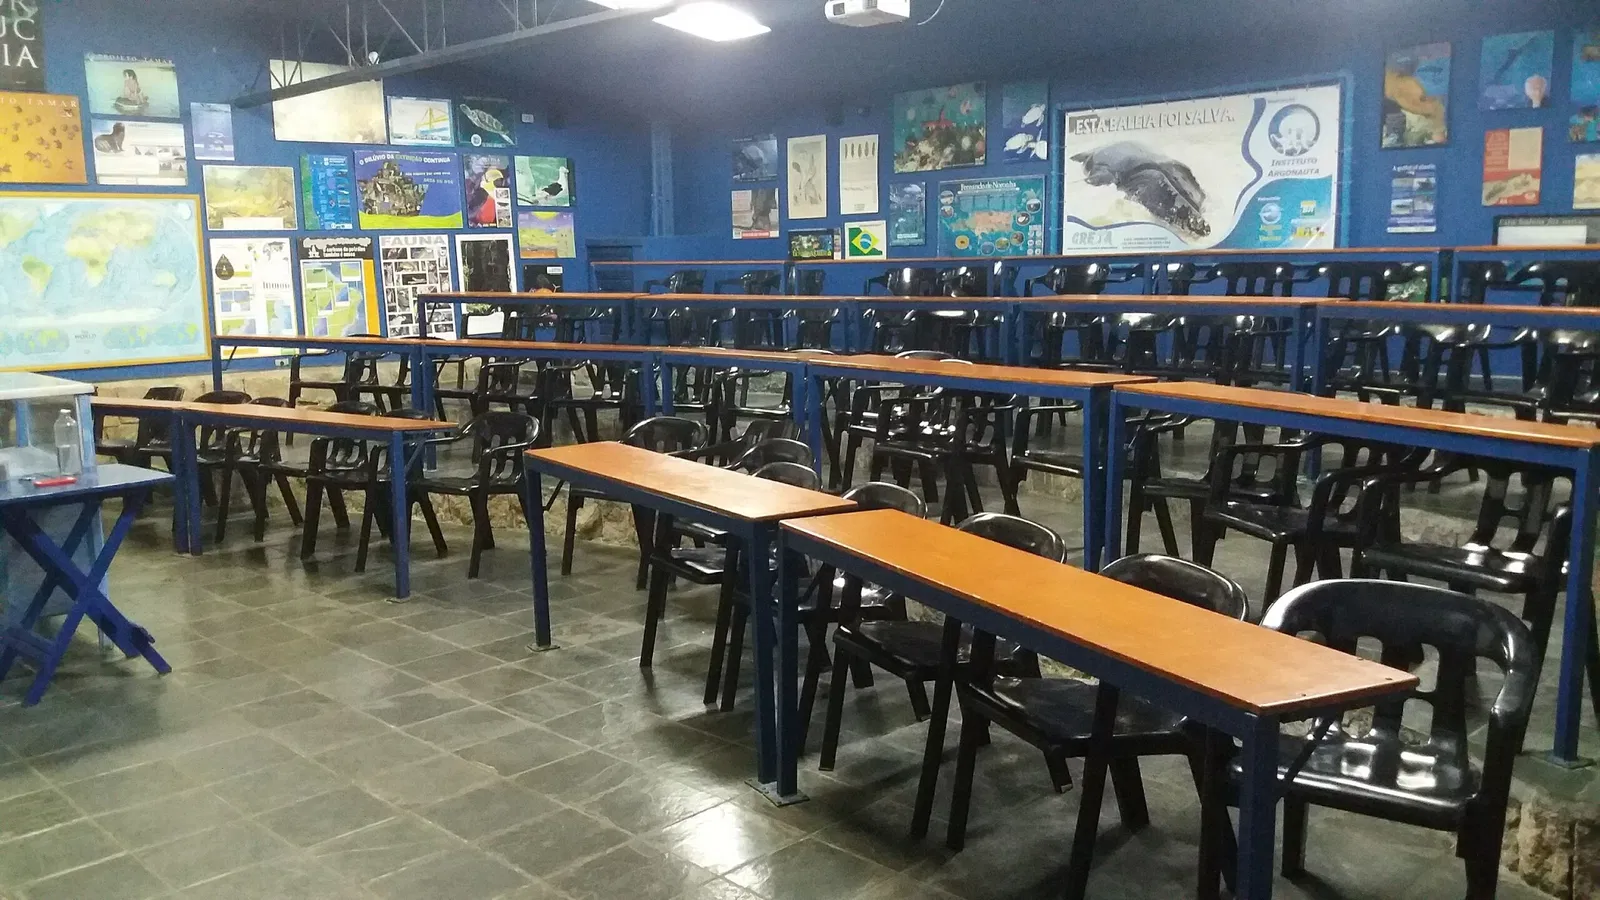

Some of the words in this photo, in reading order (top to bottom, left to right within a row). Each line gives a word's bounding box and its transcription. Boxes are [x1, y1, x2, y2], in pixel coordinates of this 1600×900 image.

[143, 57, 174, 65] TAMAR
[27, 97, 77, 107] TAMAR
[1074, 118, 1106, 135] ESTA
[1108, 114, 1155, 132] BALEIA
[1158, 111, 1181, 128] FOI
[364, 153, 386, 163] DILÚVIO
[423, 156, 451, 164] CONTINUA
[1271, 157, 1318, 167] INSTITUTO
[1267, 168, 1320, 177] ARGONAUTA
[381, 235, 446, 247] FAUNA
